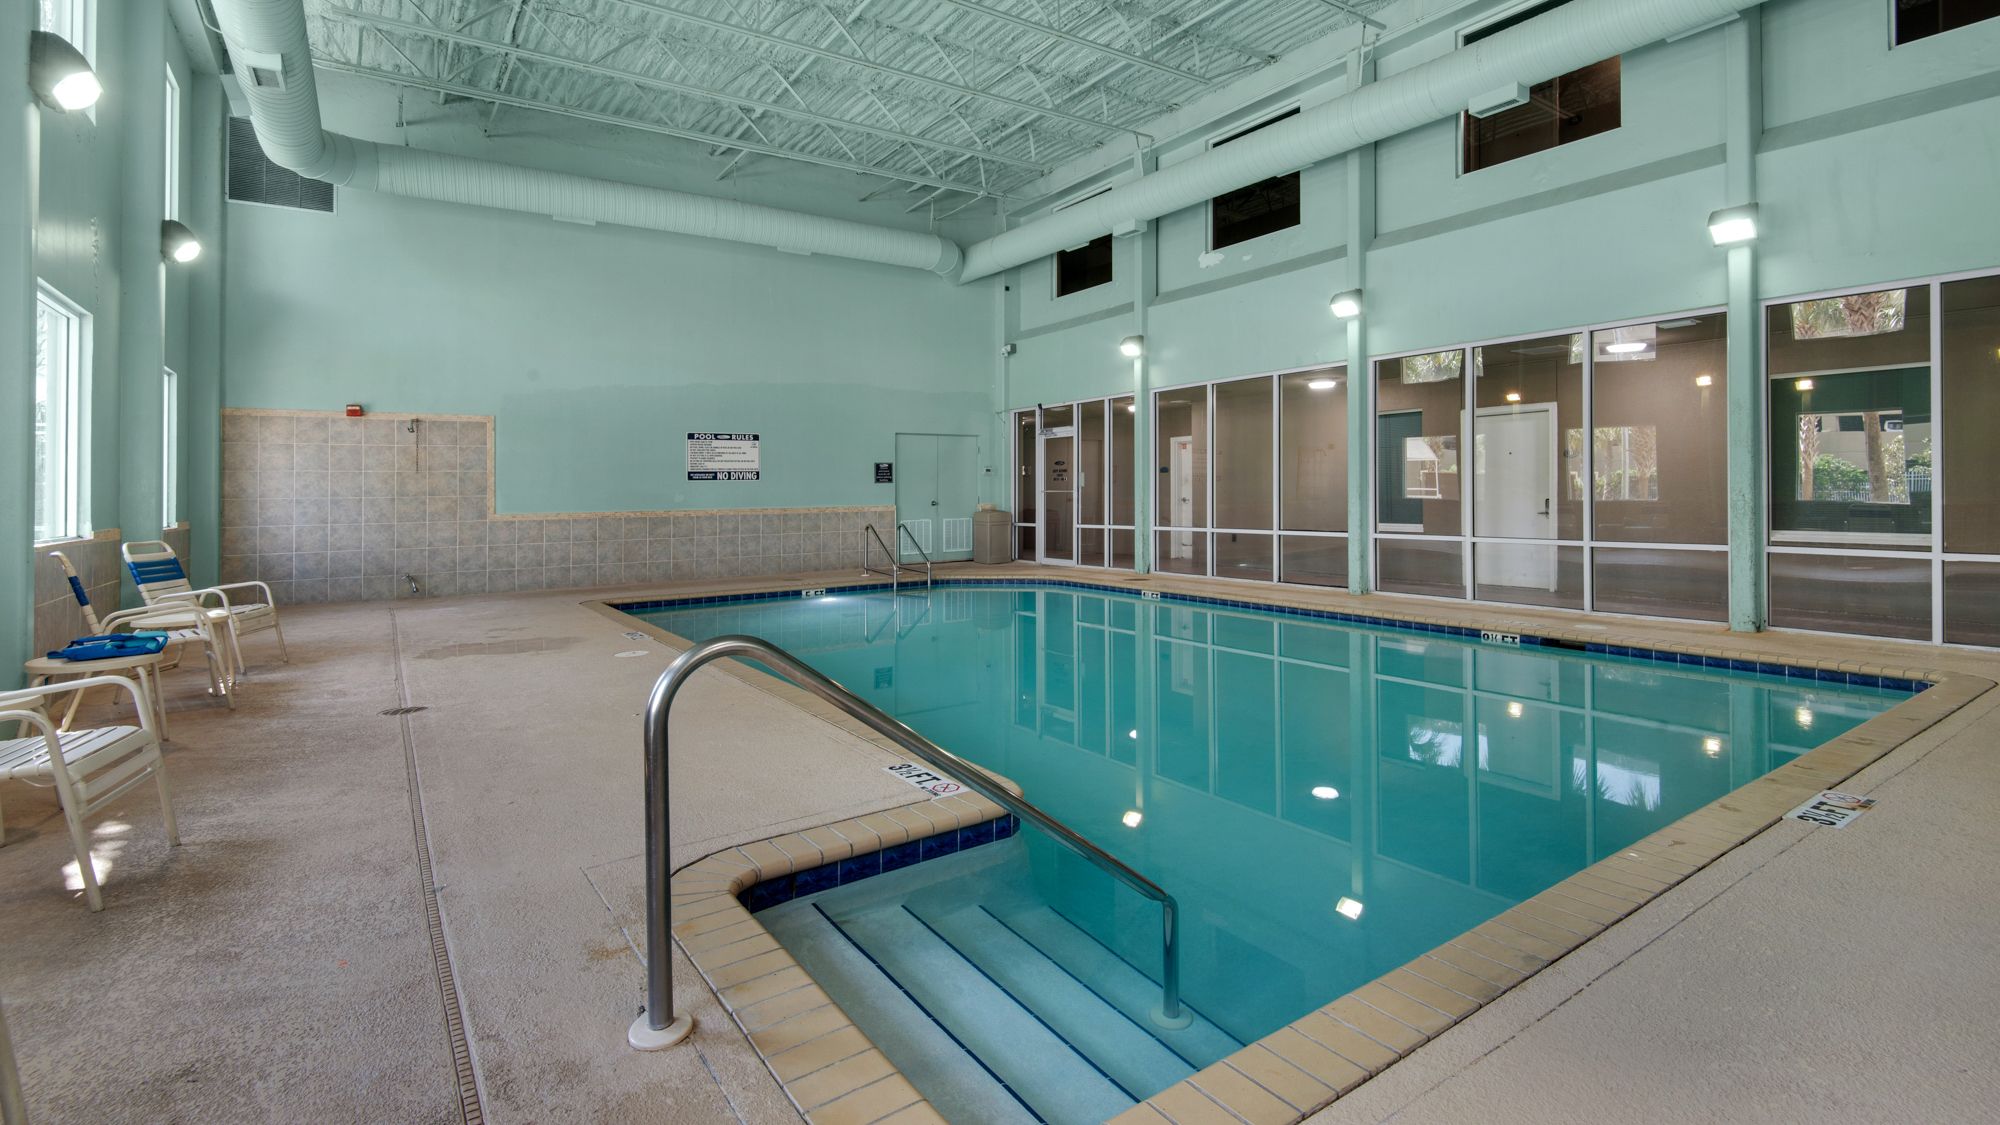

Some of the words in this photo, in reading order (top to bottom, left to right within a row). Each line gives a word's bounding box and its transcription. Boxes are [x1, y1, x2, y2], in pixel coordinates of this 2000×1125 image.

[694, 433, 716, 441] POOL
[731, 434, 754, 442] RULES
[717, 472, 729, 480] NO
[730, 472, 757, 480] DIVING
